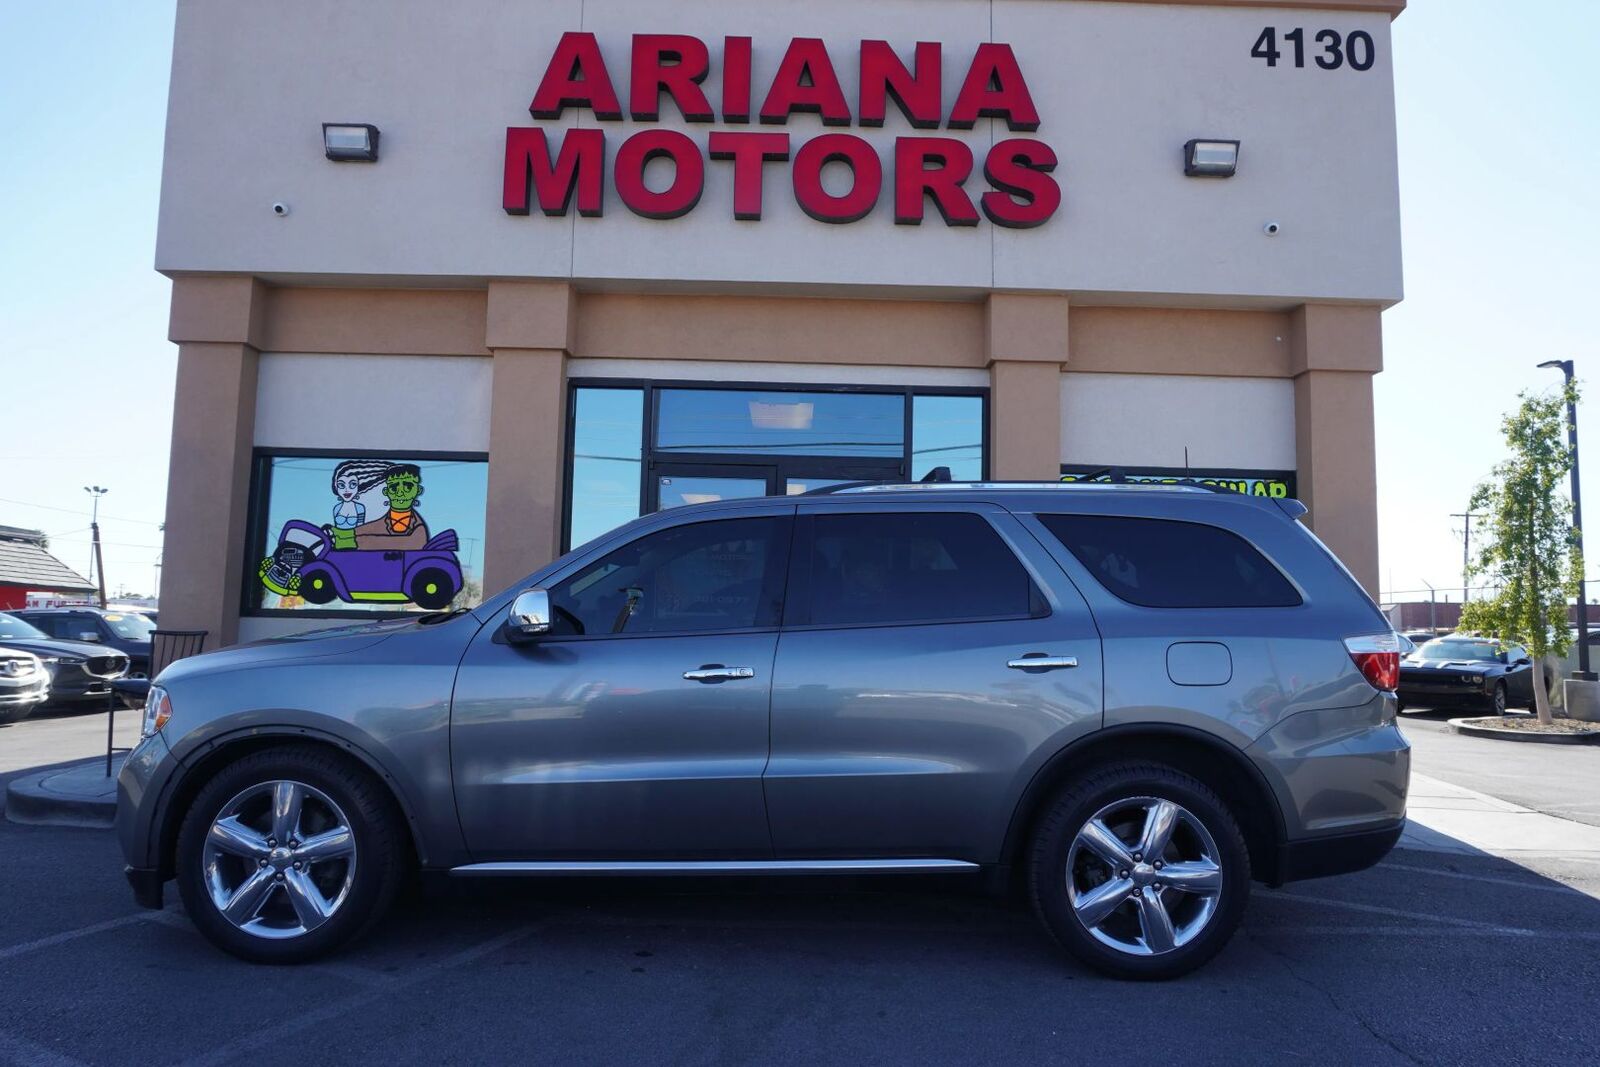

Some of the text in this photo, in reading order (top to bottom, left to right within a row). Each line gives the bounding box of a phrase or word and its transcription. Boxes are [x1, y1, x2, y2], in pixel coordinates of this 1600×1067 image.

[529, 32, 1041, 132] ARIANA
[1251, 27, 1375, 72] 4130
[503, 127, 1062, 229] MOTORS
